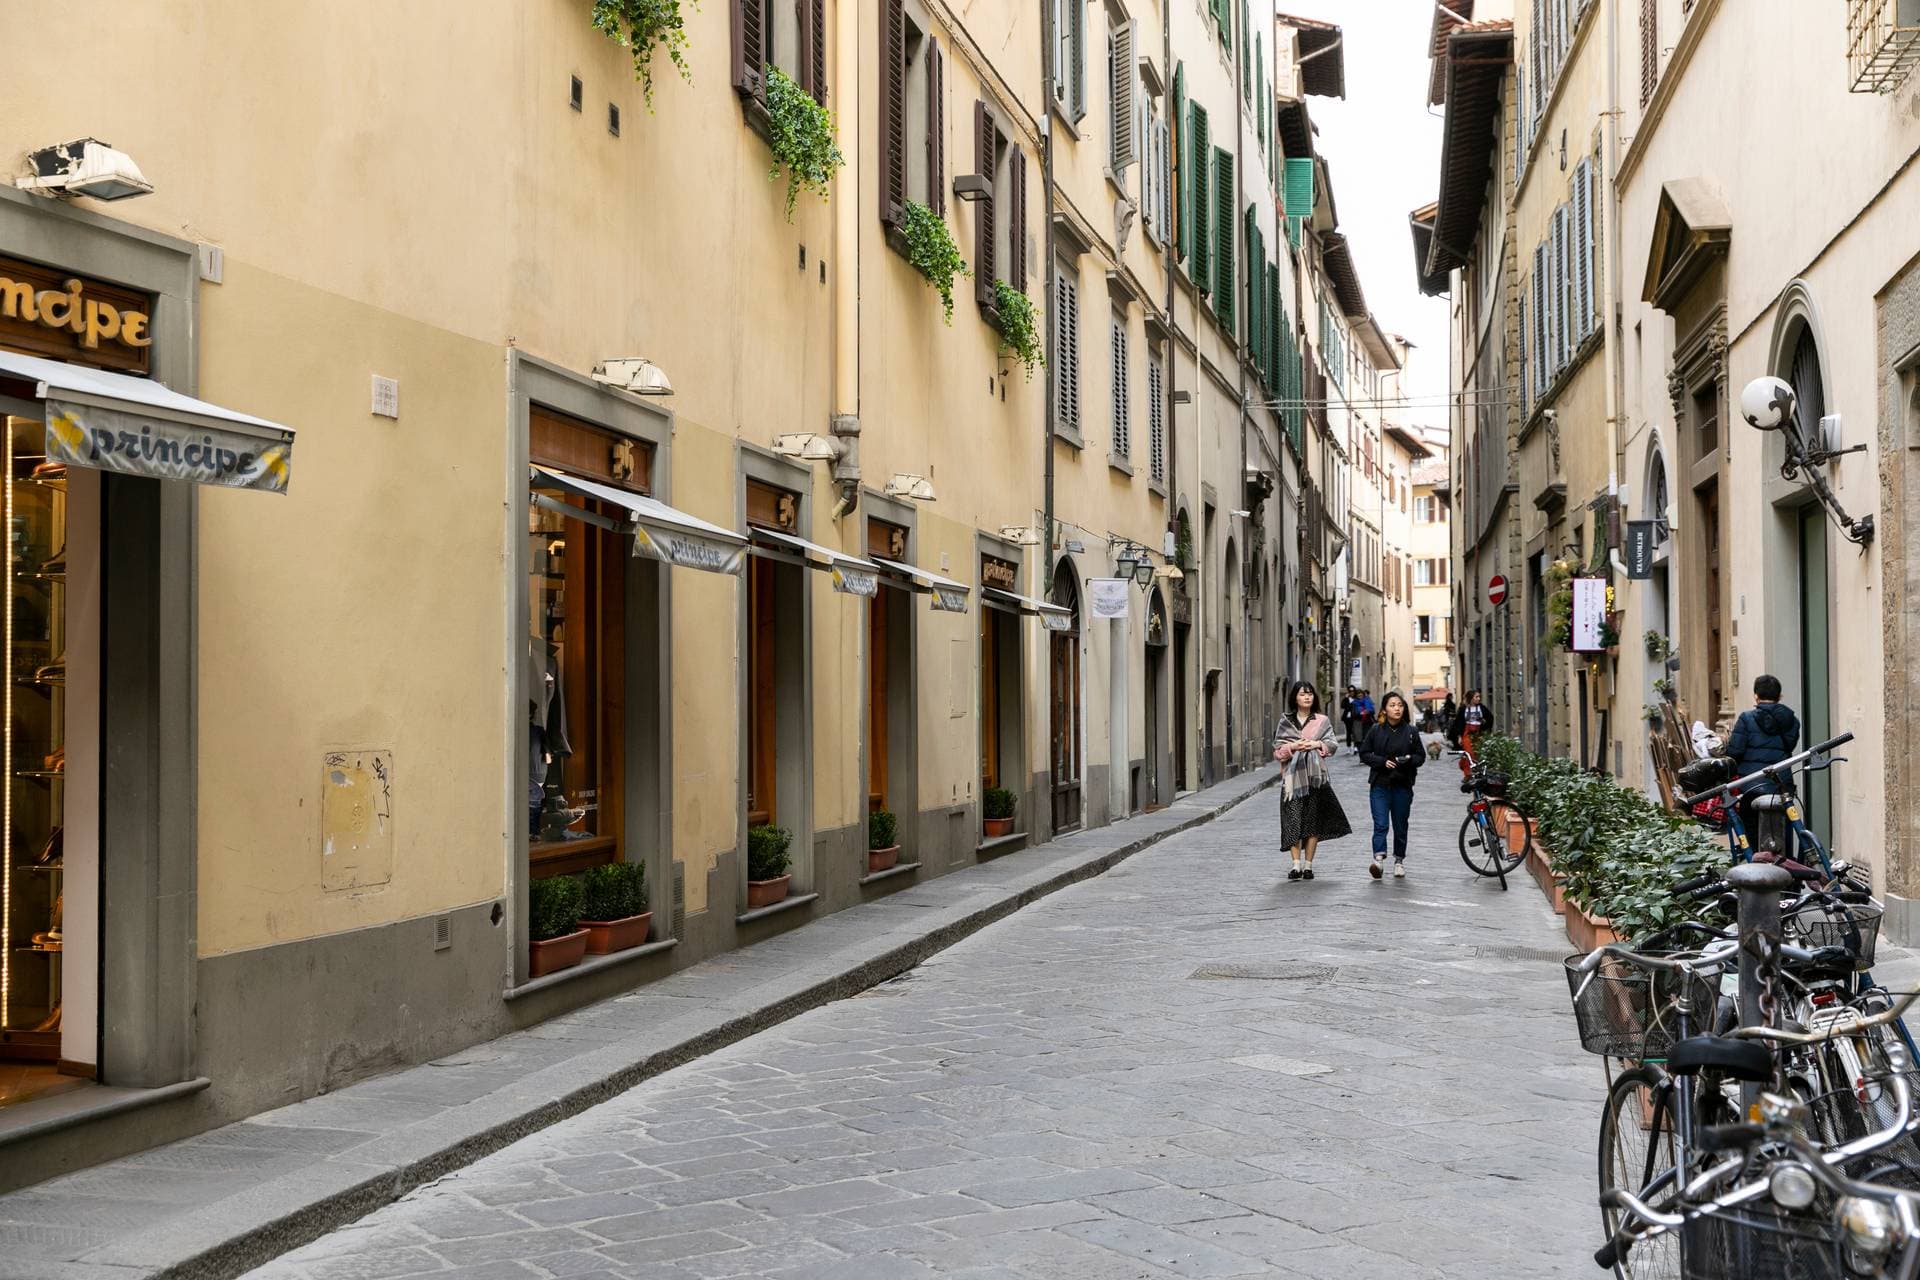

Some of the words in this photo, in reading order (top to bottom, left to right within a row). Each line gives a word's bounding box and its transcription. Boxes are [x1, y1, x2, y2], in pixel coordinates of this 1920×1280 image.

[0, 277, 152, 348] ncipe
[90, 425, 257, 477] principe
[671, 537, 720, 567] principe
[1353, 660, 1359, 668] P
